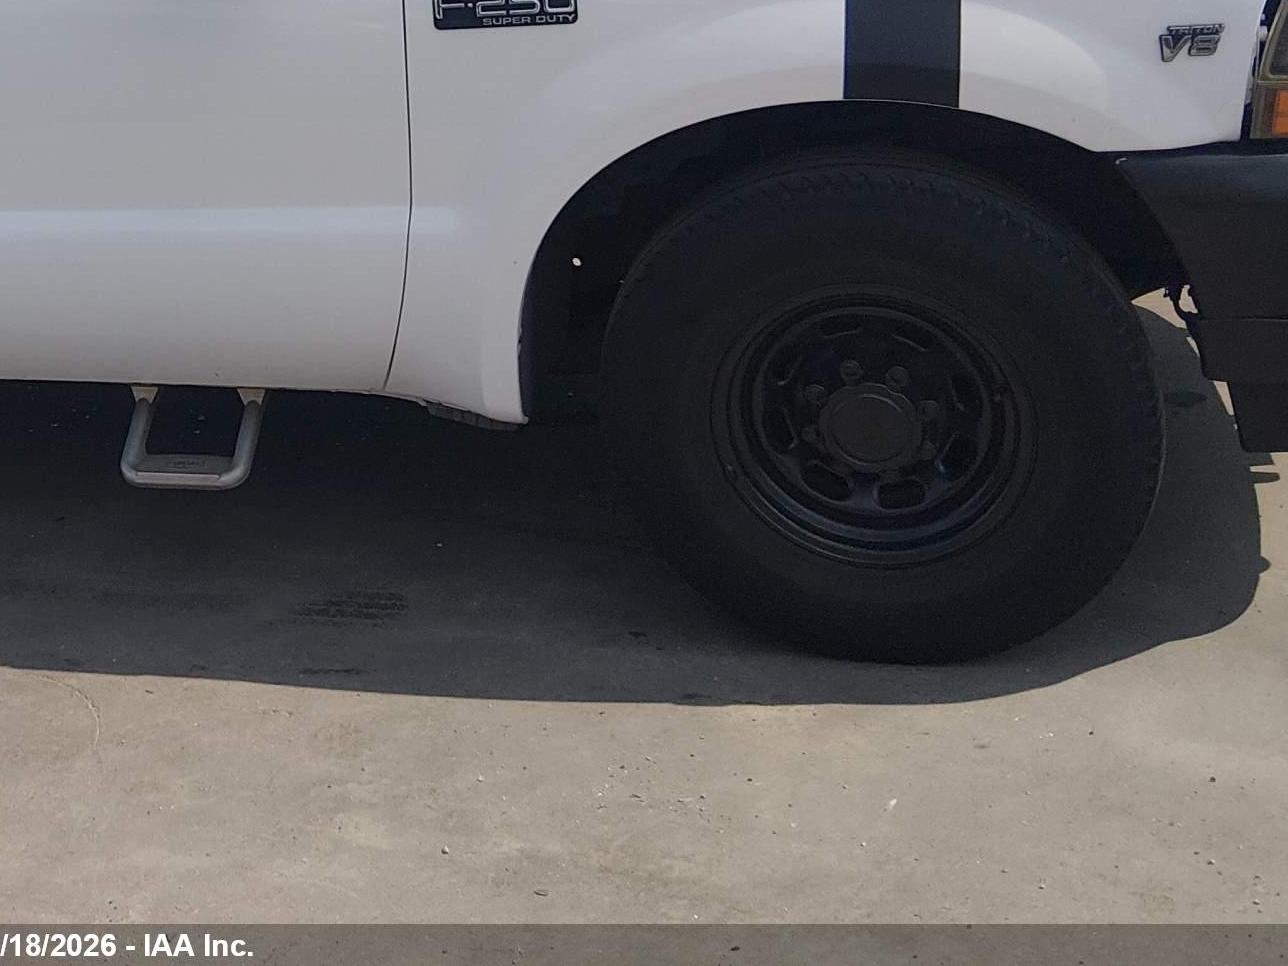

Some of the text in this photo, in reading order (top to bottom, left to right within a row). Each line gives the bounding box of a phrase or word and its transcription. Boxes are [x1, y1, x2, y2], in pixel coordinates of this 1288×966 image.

[482, 13, 576, 26] SUPER DUTY
[1159, 34, 1221, 62] V8
